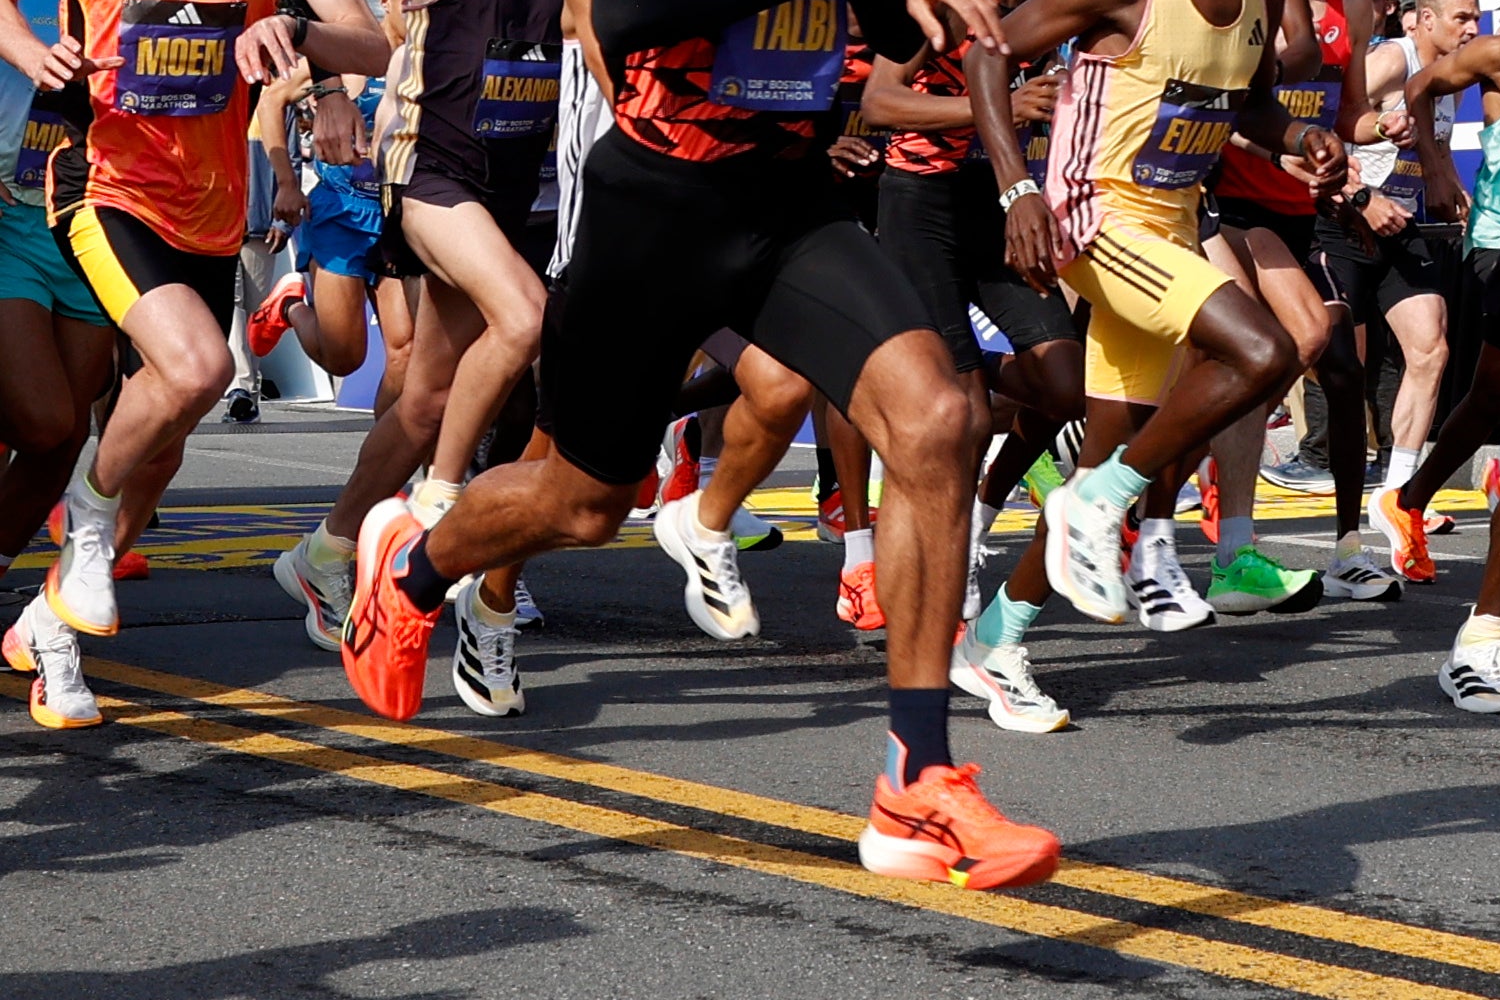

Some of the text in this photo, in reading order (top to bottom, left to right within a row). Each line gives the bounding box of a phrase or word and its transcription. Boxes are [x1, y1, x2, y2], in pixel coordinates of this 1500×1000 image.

[135, 36, 226, 77] MOEN
[480, 74, 560, 103] ALEXAND
[769, 80, 813, 89] BOSTON
[161, 93, 197, 101] BOSTON
[746, 90, 815, 101] MARATHON
[141, 101, 197, 109] MARATHON
[1158, 116, 1232, 155] EVAN
